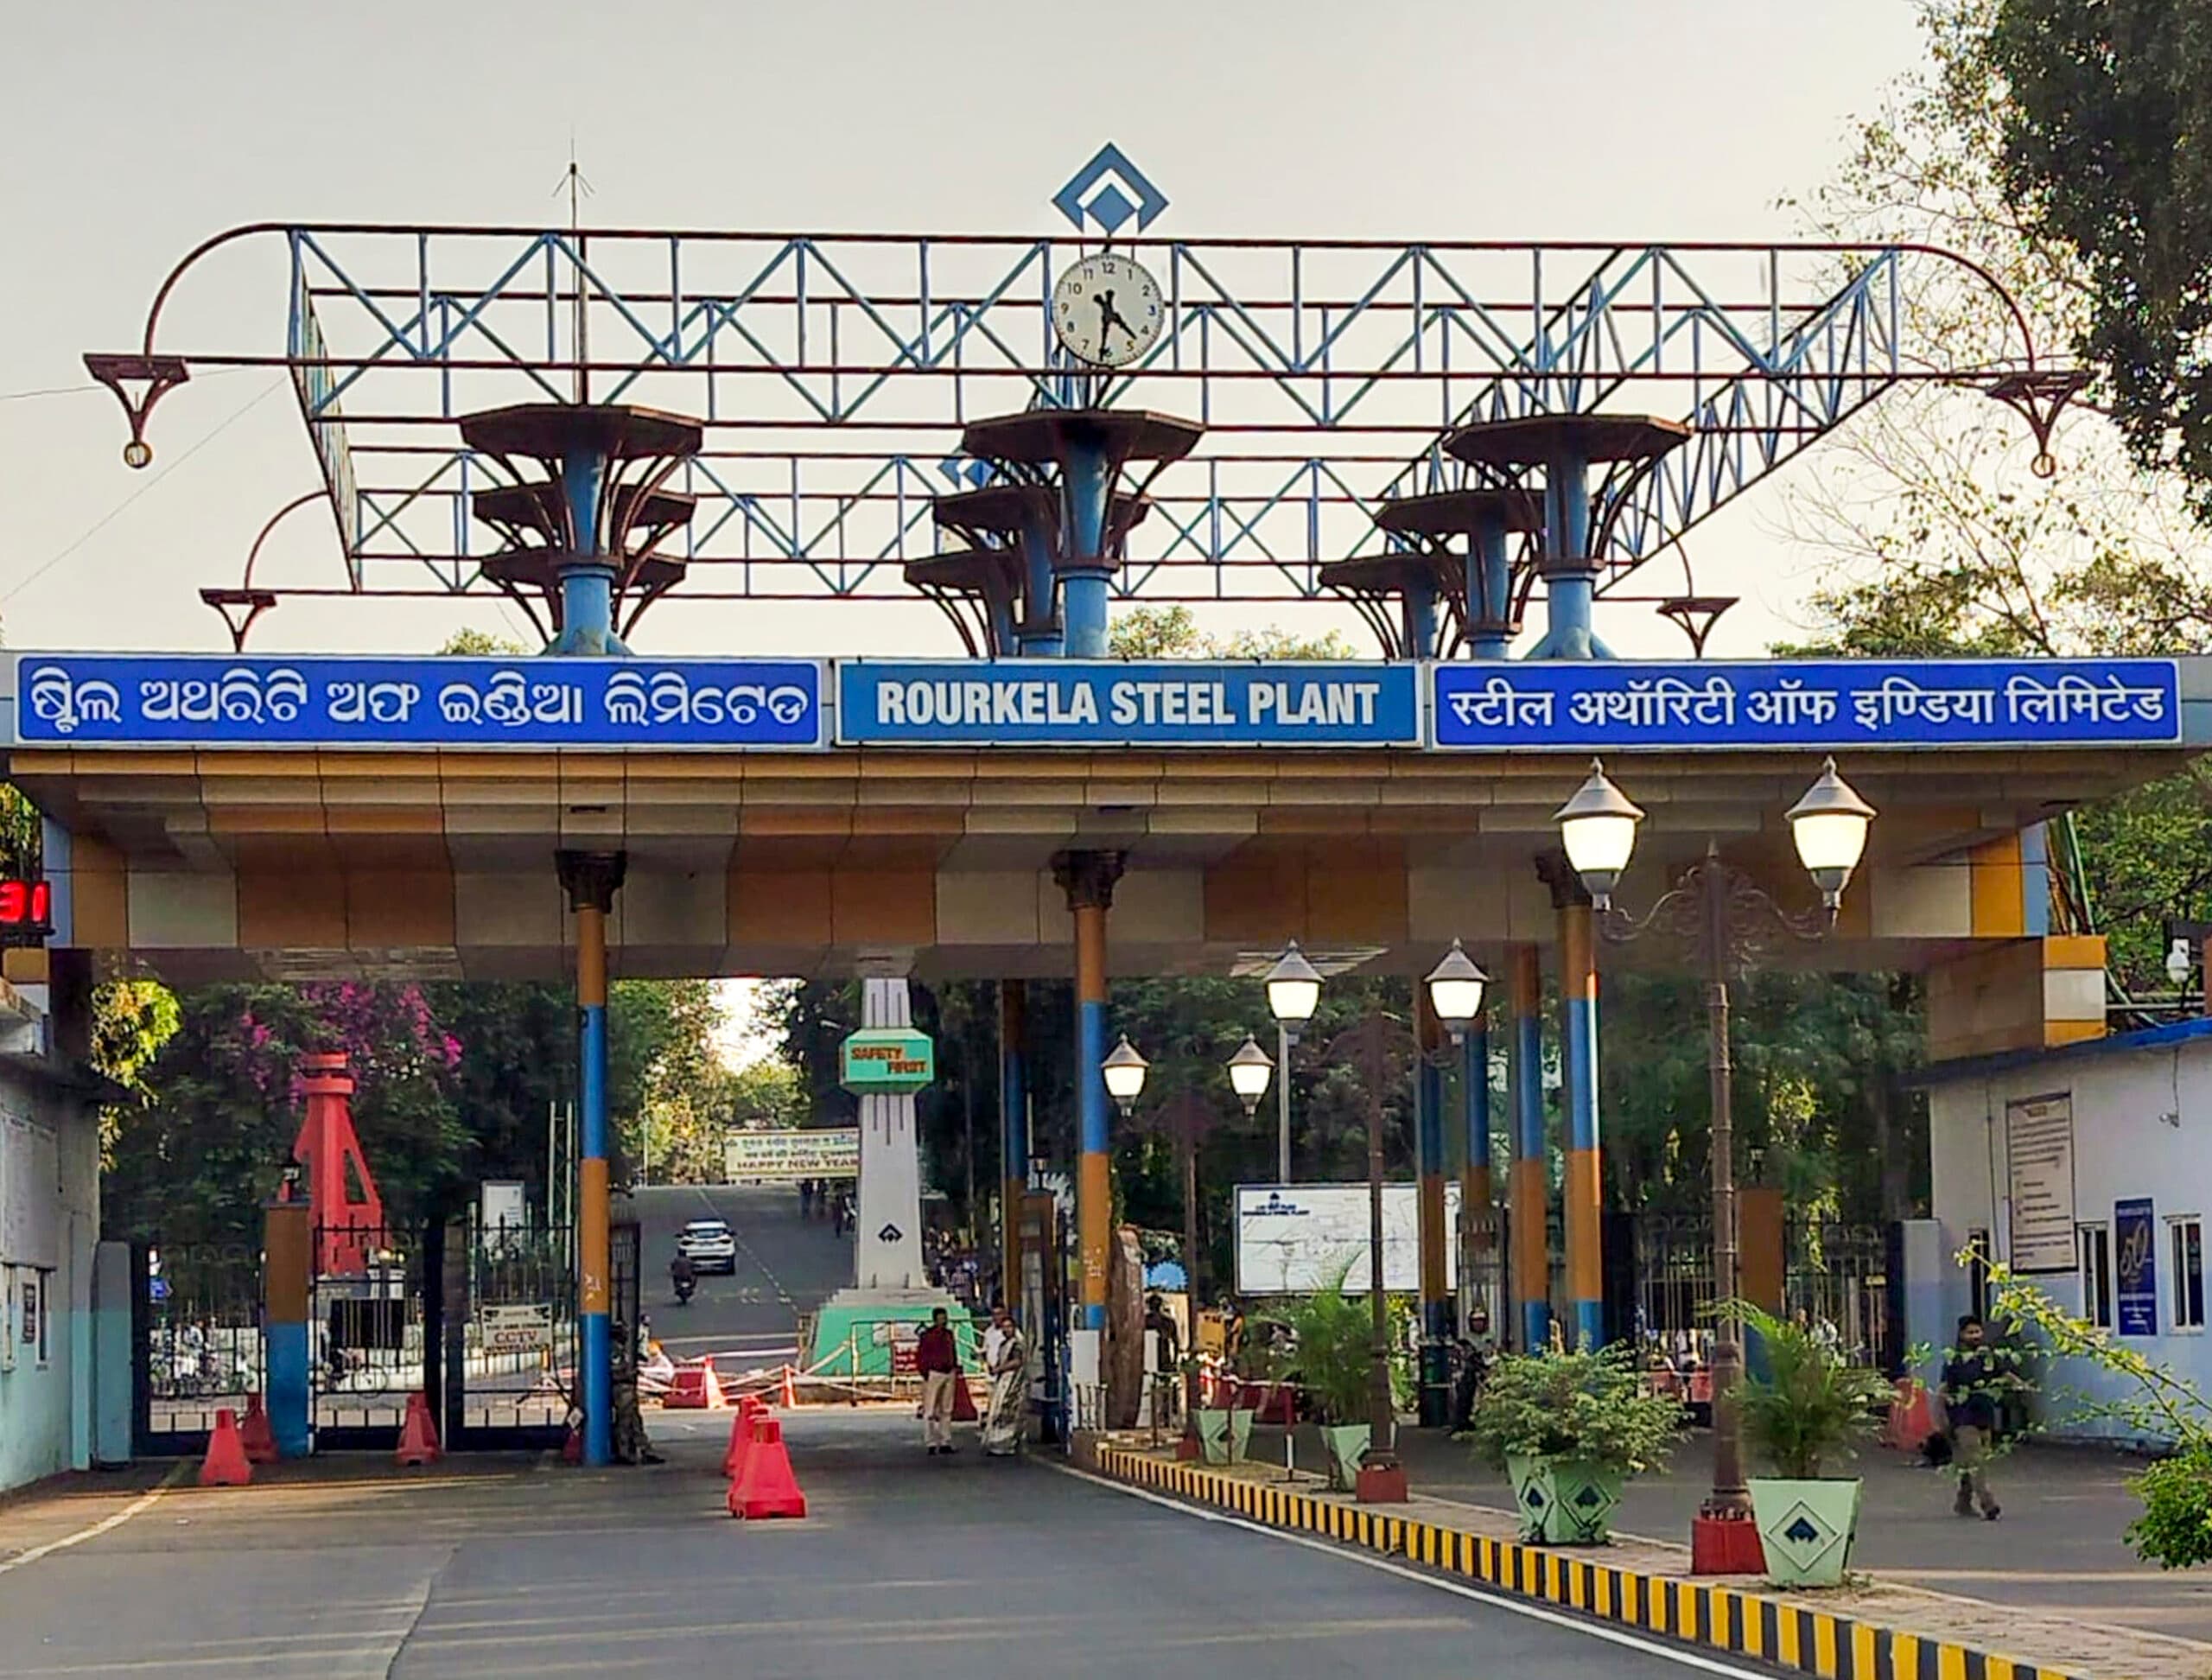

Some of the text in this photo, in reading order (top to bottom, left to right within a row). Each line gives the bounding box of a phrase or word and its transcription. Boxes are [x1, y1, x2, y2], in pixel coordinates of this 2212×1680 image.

[1102, 262, 1116, 275] 12
[1127, 269, 1133, 281] 1
[1067, 283, 1083, 295] 10
[1141, 285, 1150, 296] 2
[1060, 303, 1070, 315] 9
[1147, 305, 1156, 315] 3
[1126, 340, 1135, 352] 5
[140, 667, 308, 725] ଅଥରିଟି
[327, 681, 421, 722] ଅଫ
[438, 671, 582, 727] ଇଣ୍ଡିଆ
[604, 671, 809, 726] ଲିମିଟେଡ
[877, 681, 1380, 725] ROURKELA STEEL PLANT
[1448, 674, 2165, 730] स्टील अथॉरिटी ऑफ इण्डिया लिमिटेड
[851, 1047, 903, 1060] SAFETY
[887, 1060, 927, 1074] FIRST
[737, 1160, 785, 1168] HAPPY
[788, 1159, 820, 1168] NEW
[494, 1330, 538, 1343] CCTV
